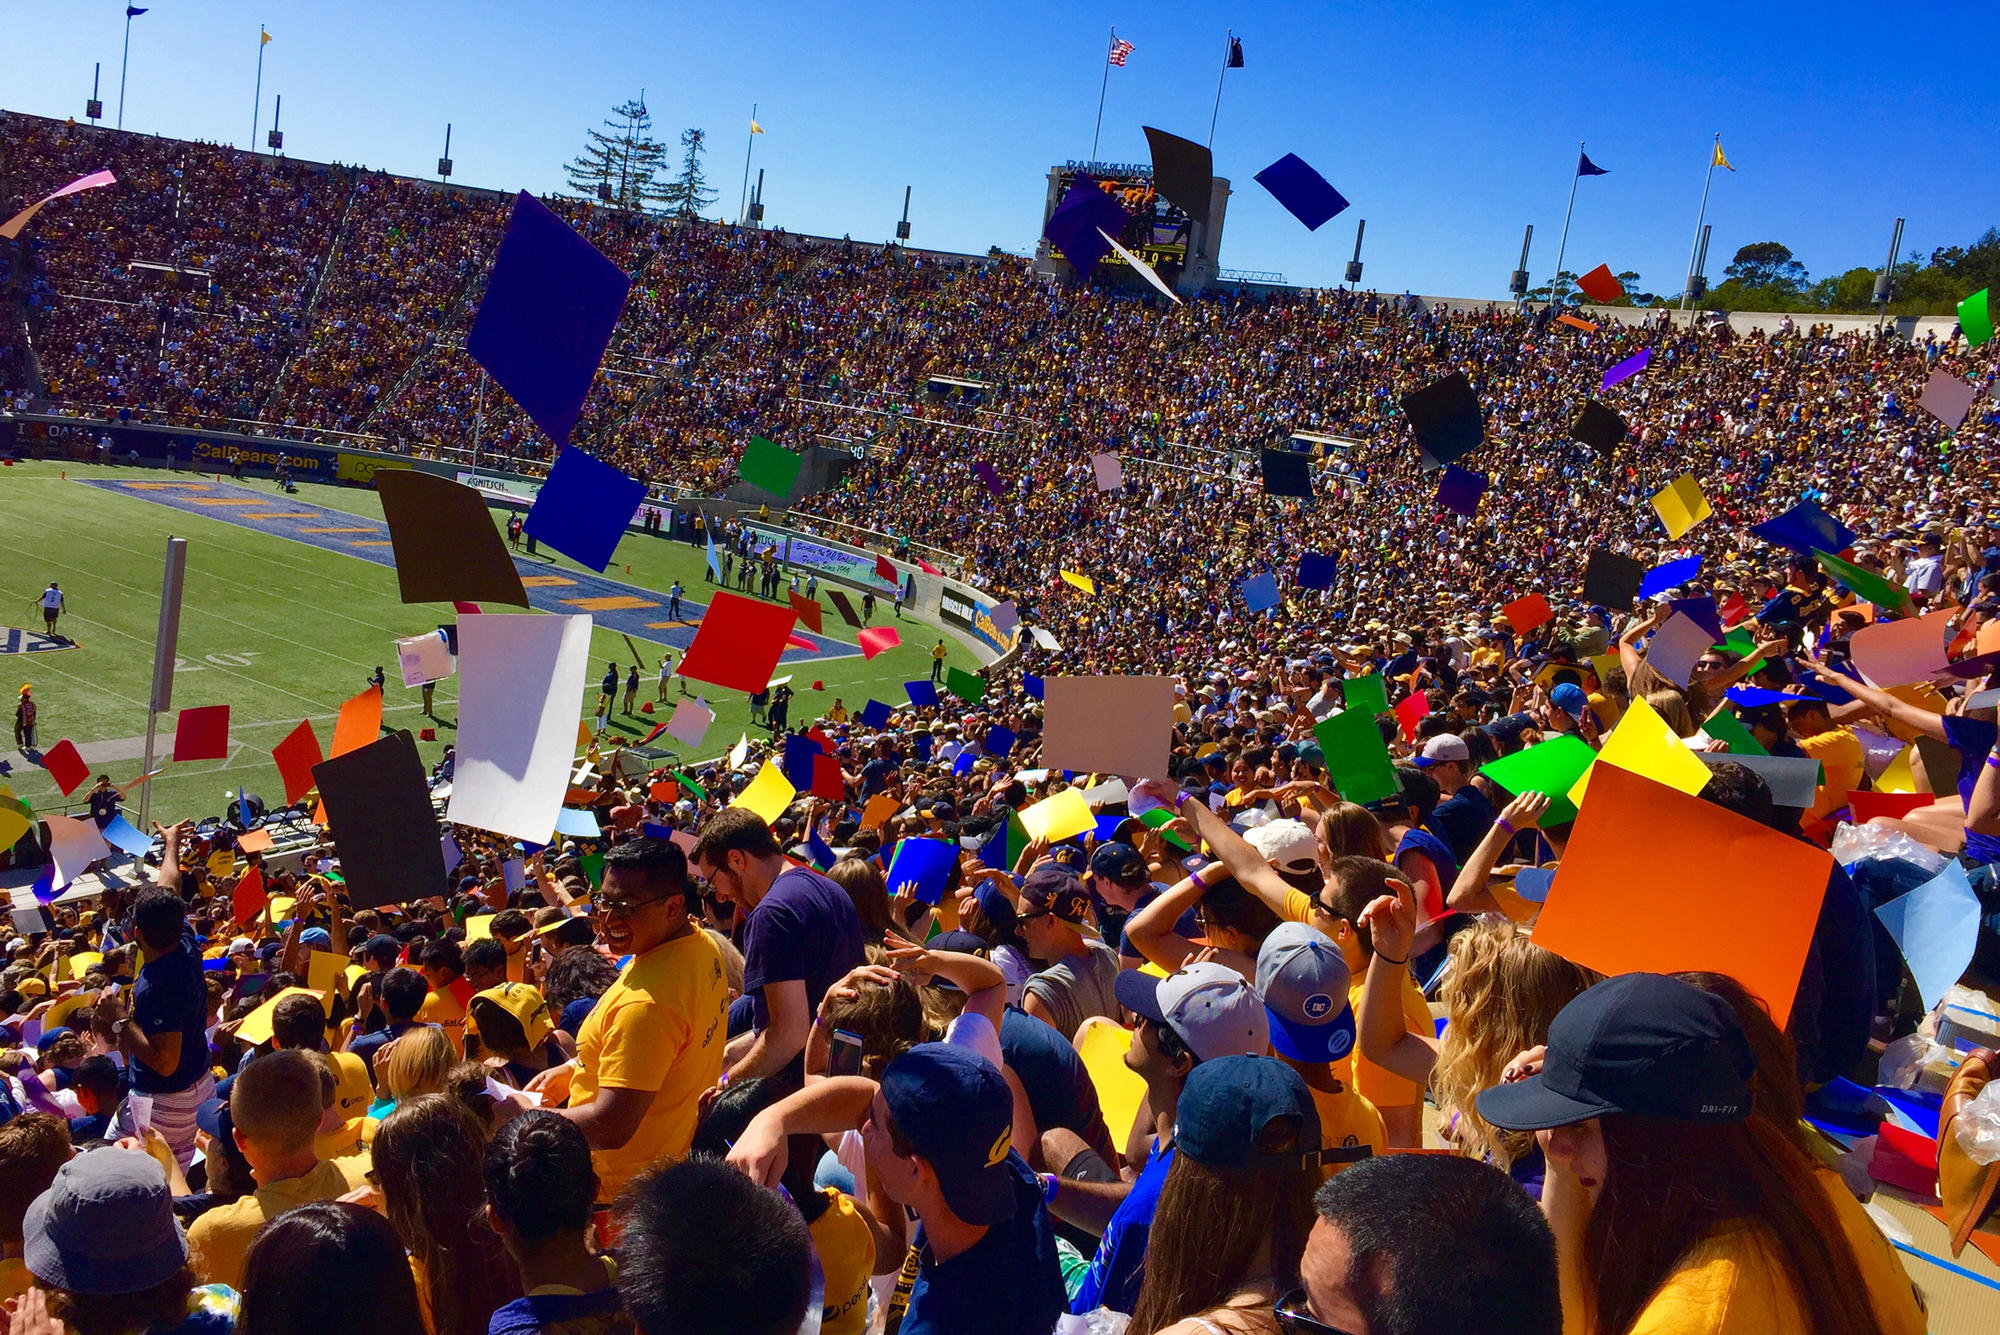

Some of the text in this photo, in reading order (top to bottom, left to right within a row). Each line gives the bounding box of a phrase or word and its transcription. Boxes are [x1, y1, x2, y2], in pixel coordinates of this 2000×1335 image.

[1121, 163, 1153, 176] WES
[850, 446, 864, 460] 40
[1700, 1104, 1738, 1114] DRI-FIT
